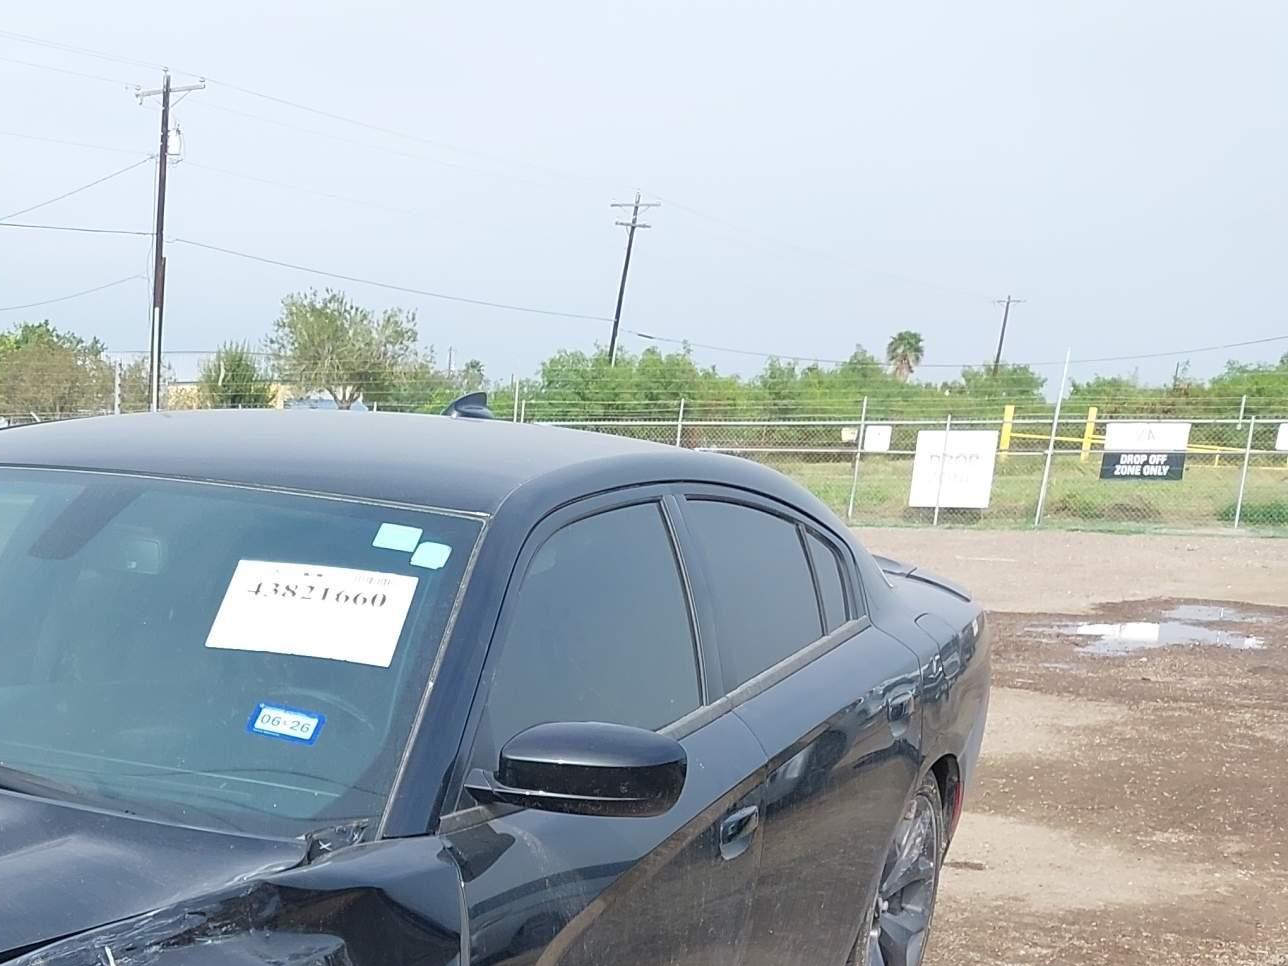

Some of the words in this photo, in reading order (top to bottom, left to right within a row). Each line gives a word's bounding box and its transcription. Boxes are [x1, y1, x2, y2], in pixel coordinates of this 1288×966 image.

[1120, 454, 1147, 465] DROP
[1148, 454, 1168, 465] OFF
[1114, 465, 1142, 475] ZONE
[1142, 465, 1170, 475] ONLY
[247, 582, 387, 607] 43821660
